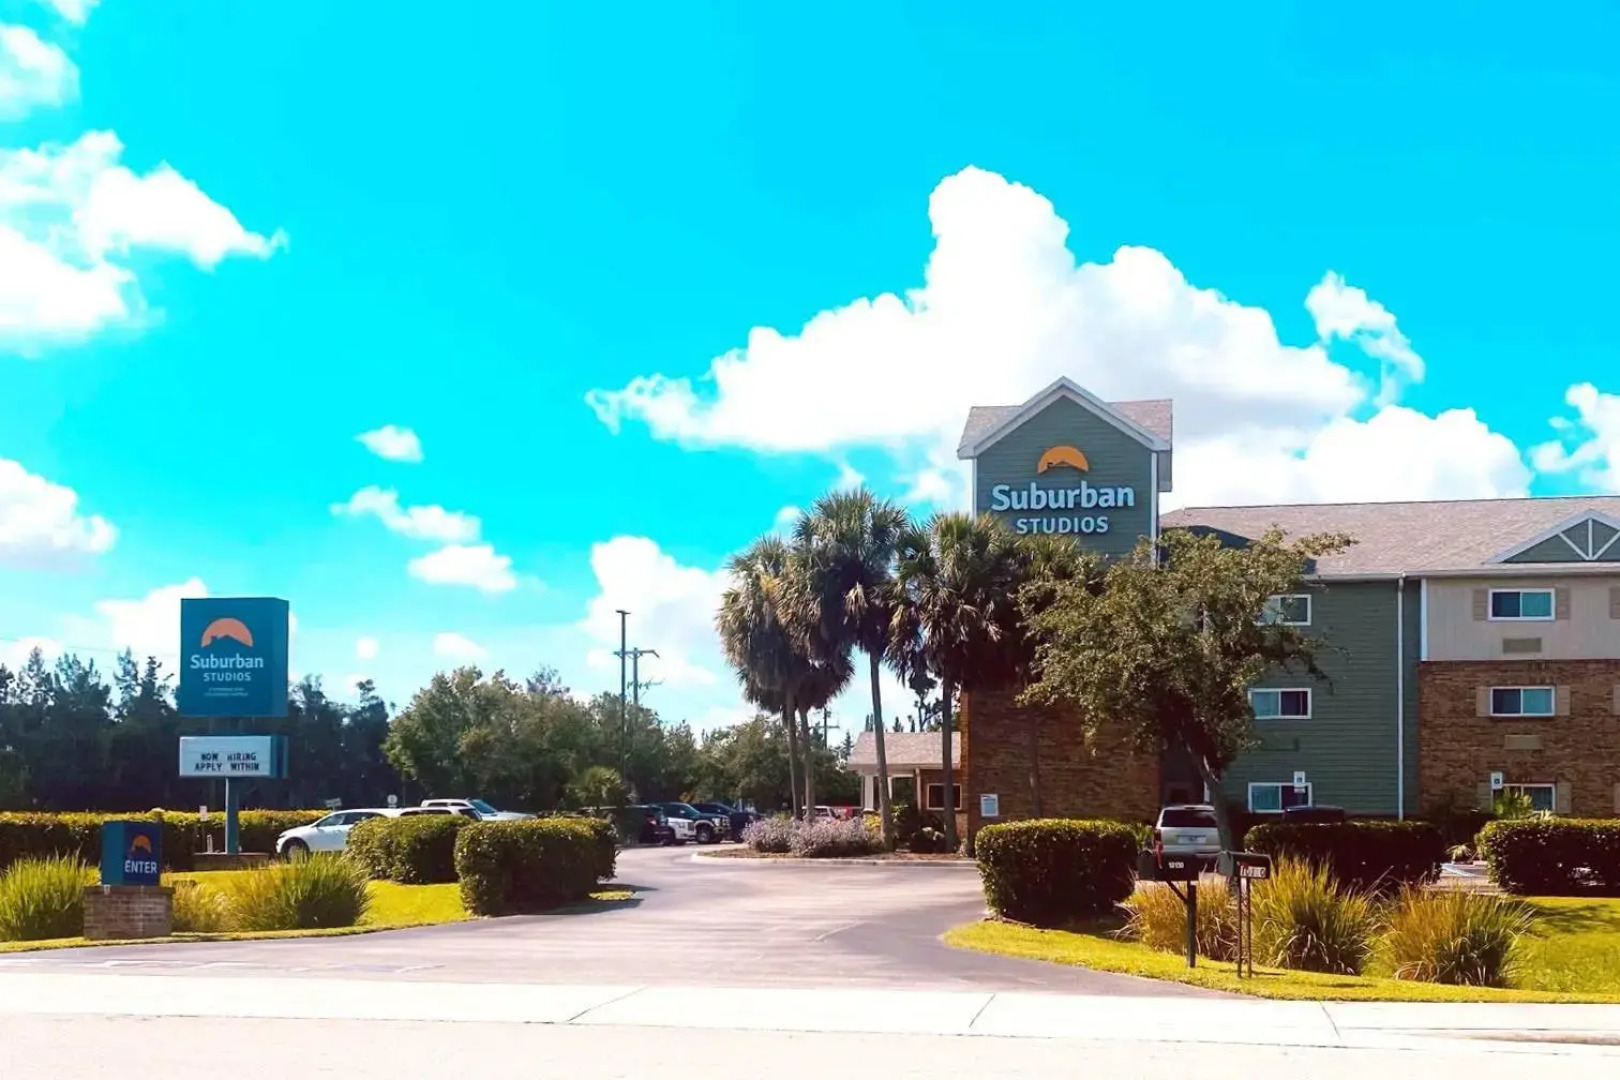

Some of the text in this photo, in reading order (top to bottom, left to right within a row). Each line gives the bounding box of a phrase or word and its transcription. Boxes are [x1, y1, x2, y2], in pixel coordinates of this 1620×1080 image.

[991, 480, 1135, 512] Suburban
[1016, 516, 1109, 535] STUDIOS
[190, 653, 264, 669] Suburban
[203, 672, 252, 682] STUDIOS
[201, 752, 257, 761] NOW HIRING
[195, 762, 260, 771] APPLY WITHIN
[124, 860, 158, 874] ENTER
